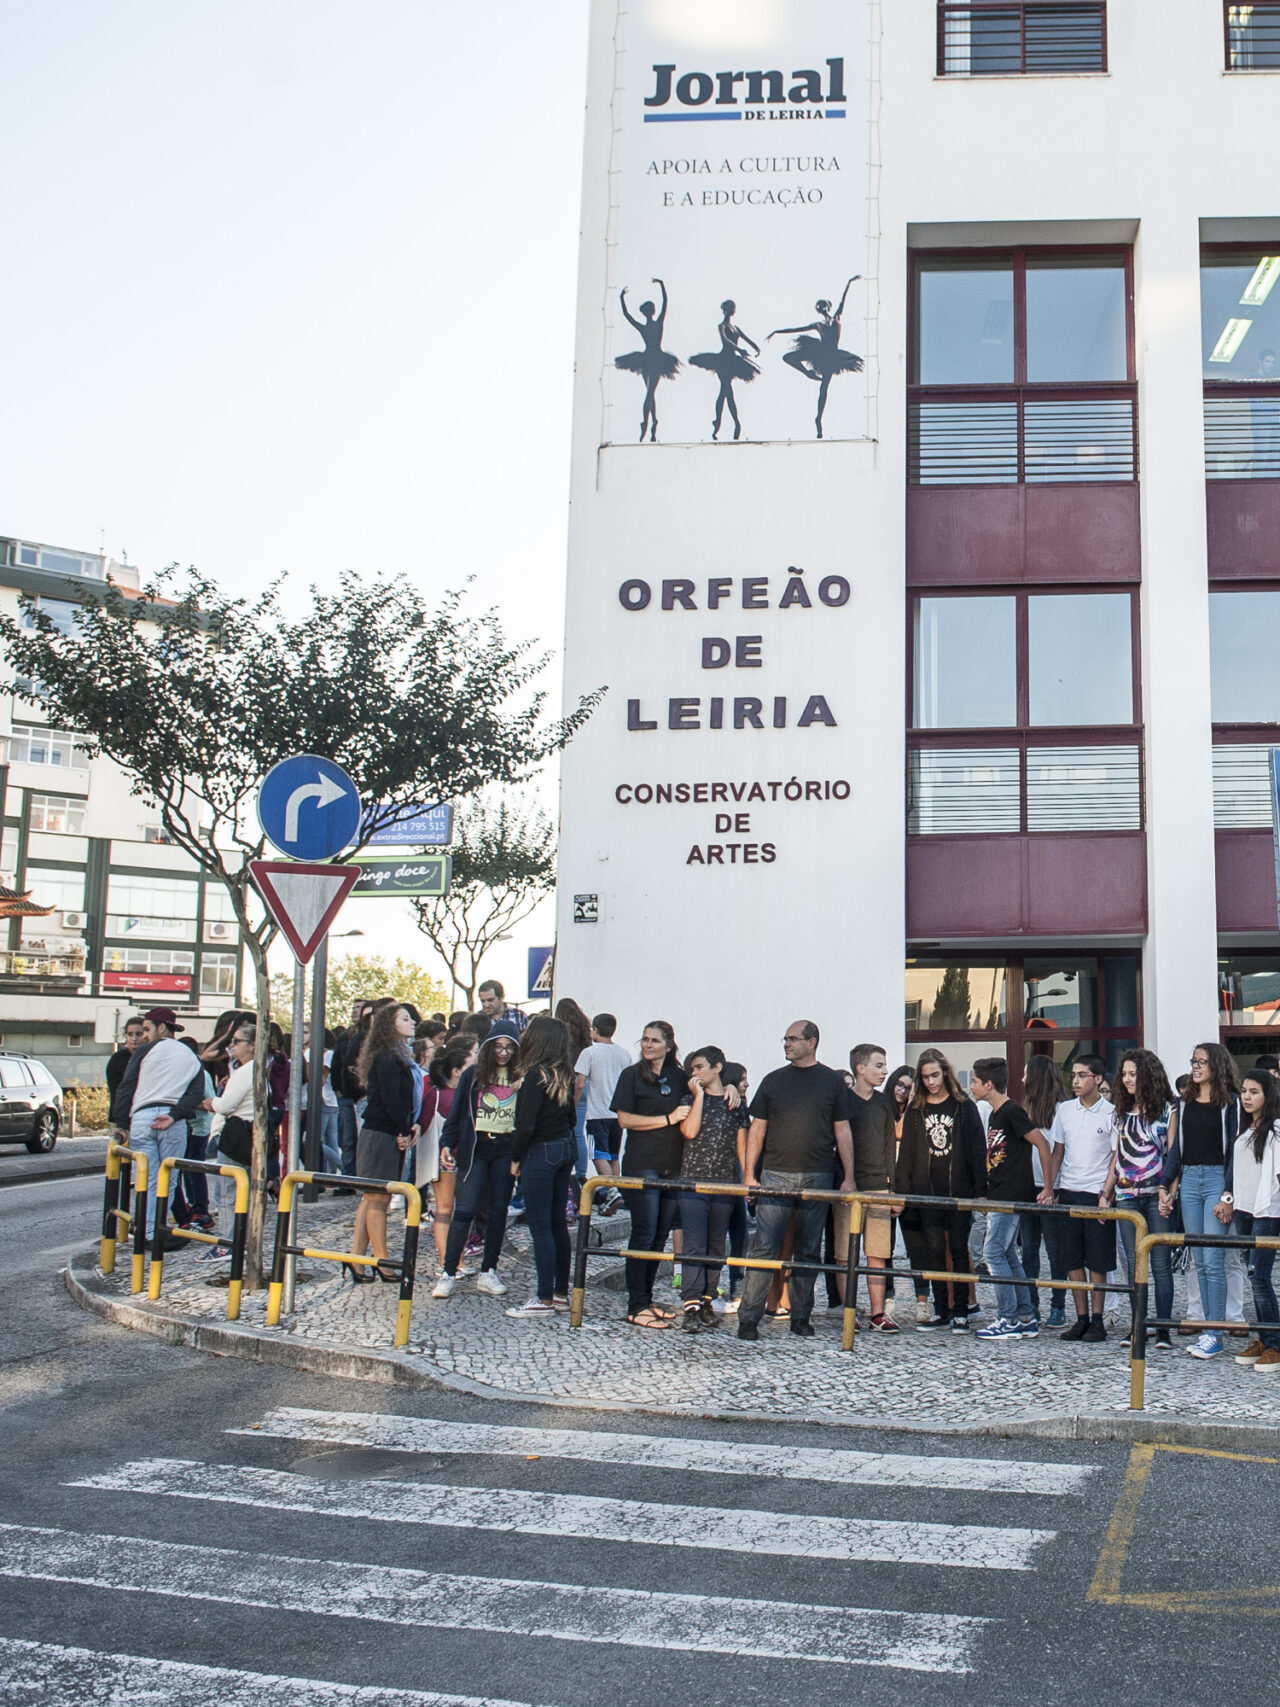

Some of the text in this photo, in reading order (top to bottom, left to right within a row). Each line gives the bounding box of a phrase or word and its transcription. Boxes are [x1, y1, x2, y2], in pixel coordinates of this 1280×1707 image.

[644, 57, 847, 107] Jornal
[744, 109, 824, 120] DE LEIRIA
[646, 156, 841, 175] APOIA A CULTURA
[663, 186, 824, 208] E A EDUCAÇÃO
[618, 566, 851, 612] ORFEÃO
[701, 635, 763, 670] DE
[627, 695, 838, 732] LEIRIA
[615, 777, 851, 805] CONSERVATÓRIO
[391, 822, 445, 831] 214 795 515
[715, 813, 751, 834] DE
[687, 843, 777, 866] ARTES
[358, 868, 391, 886] ingo
[394, 864, 430, 878] doce
